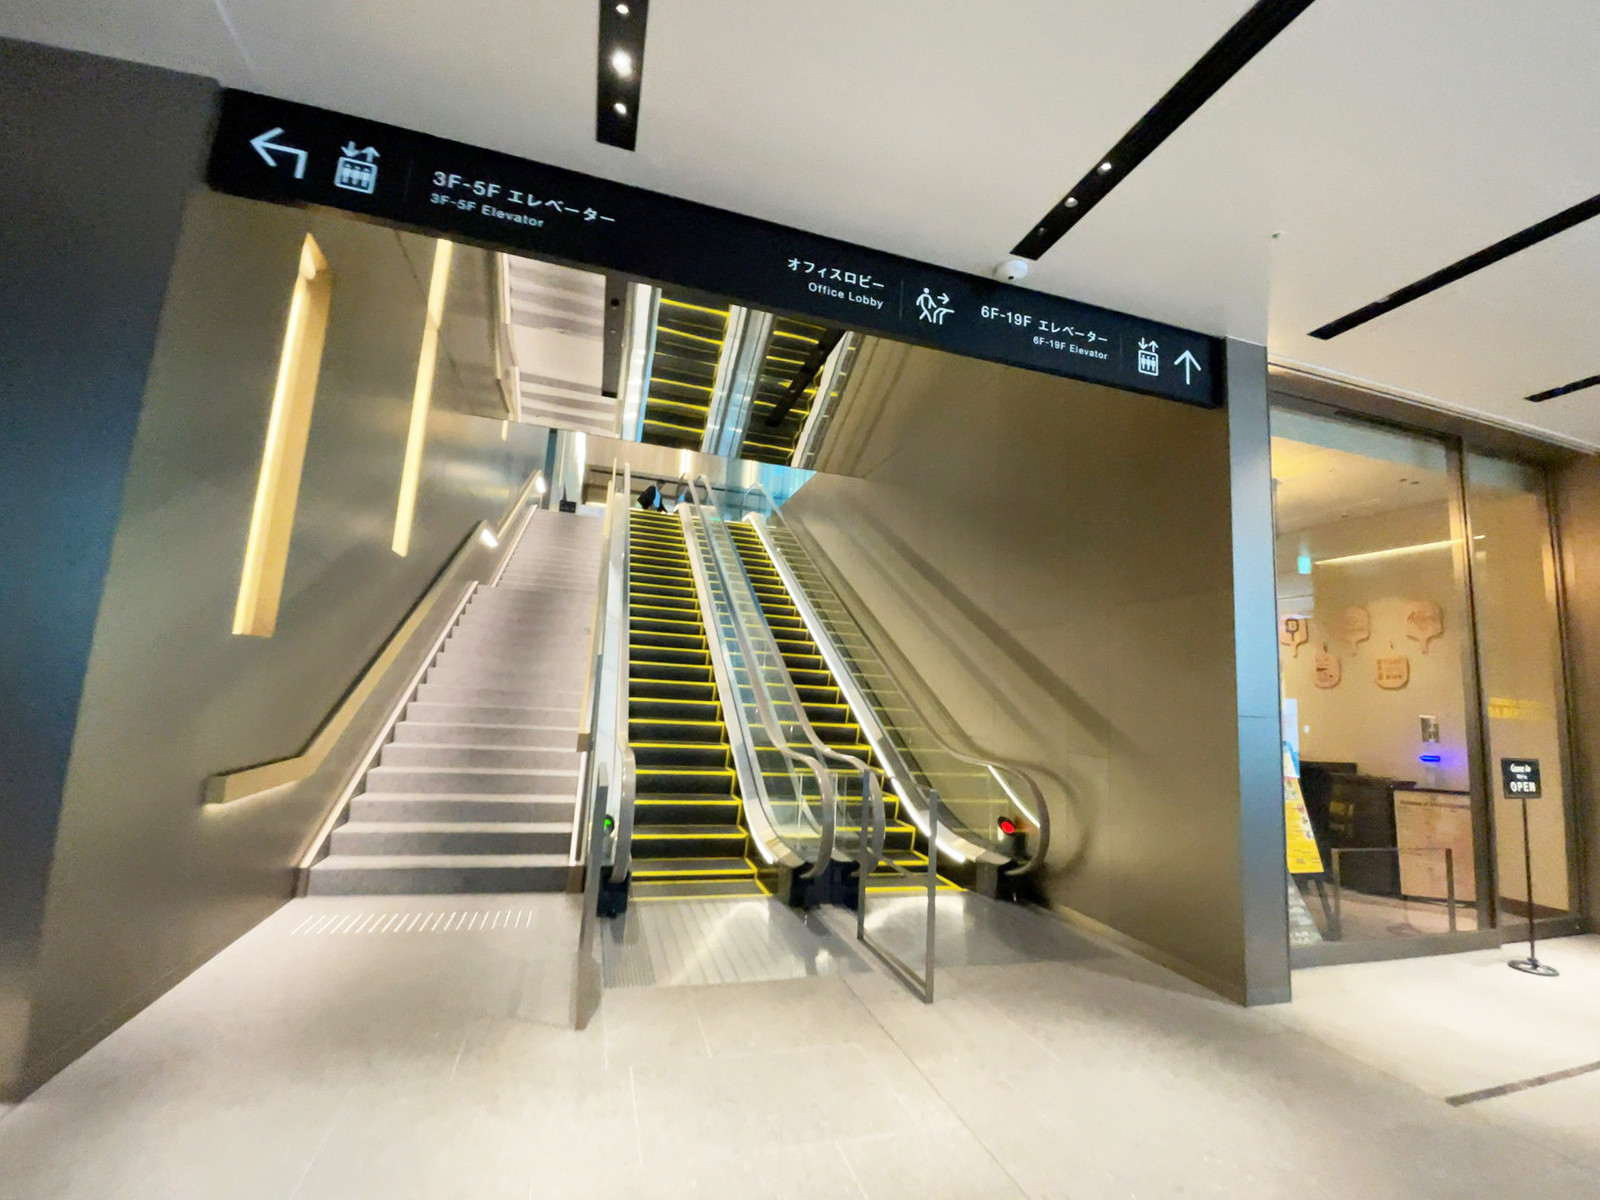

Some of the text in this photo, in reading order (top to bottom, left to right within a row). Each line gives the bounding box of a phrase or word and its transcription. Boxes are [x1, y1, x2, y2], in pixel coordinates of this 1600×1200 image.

[430, 192, 544, 228] 3F-5F Elevator
[432, 170, 616, 222] 3F-5F エレベーター
[787, 257, 885, 289] オフィスロビー
[808, 281, 884, 310] Office Lobby
[980, 305, 1108, 343] 6F-19F エレベーター
[1032, 335, 1108, 360] 6F-19F Elevator
[1510, 781, 1536, 793] OPEN
